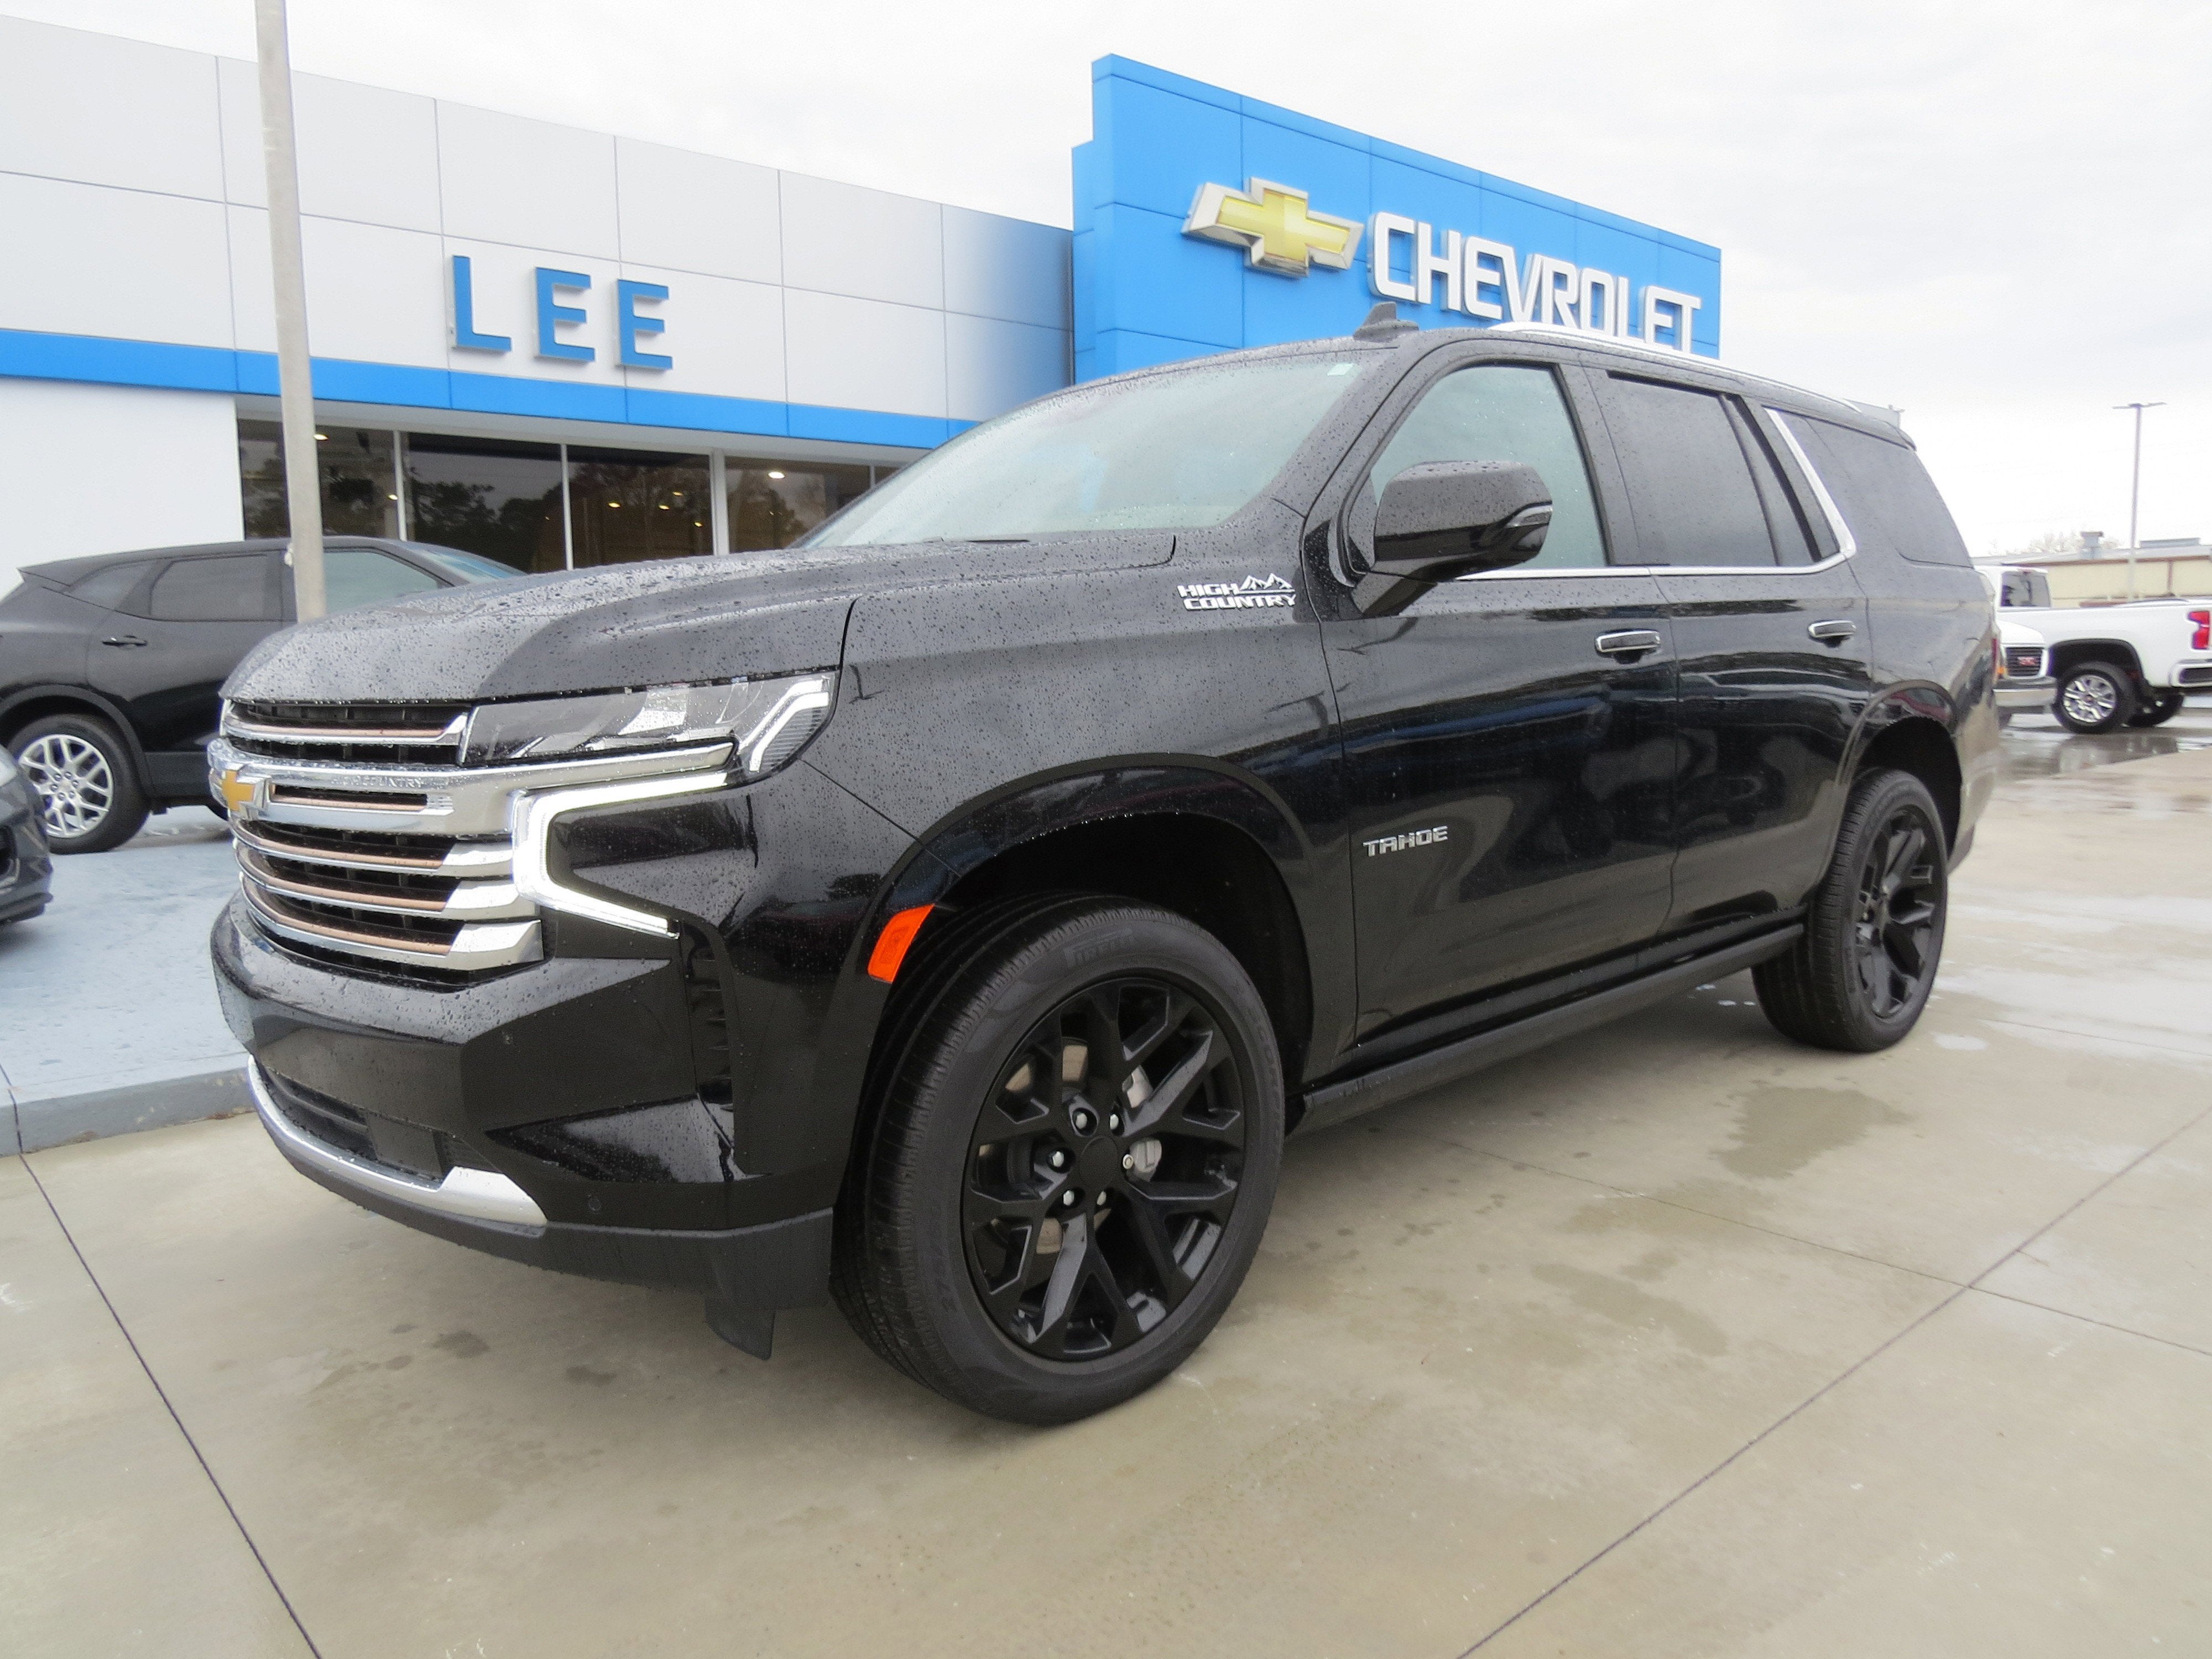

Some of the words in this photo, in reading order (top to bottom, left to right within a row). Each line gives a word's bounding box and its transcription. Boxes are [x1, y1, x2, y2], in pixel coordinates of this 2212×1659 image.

[1370, 211, 1702, 353] CHEVROLET
[452, 254, 673, 370] LEE
[1177, 583, 1240, 598] HIGH
[1183, 594, 1296, 611] COUNTRY
[1362, 825, 1448, 857] TAHOE
